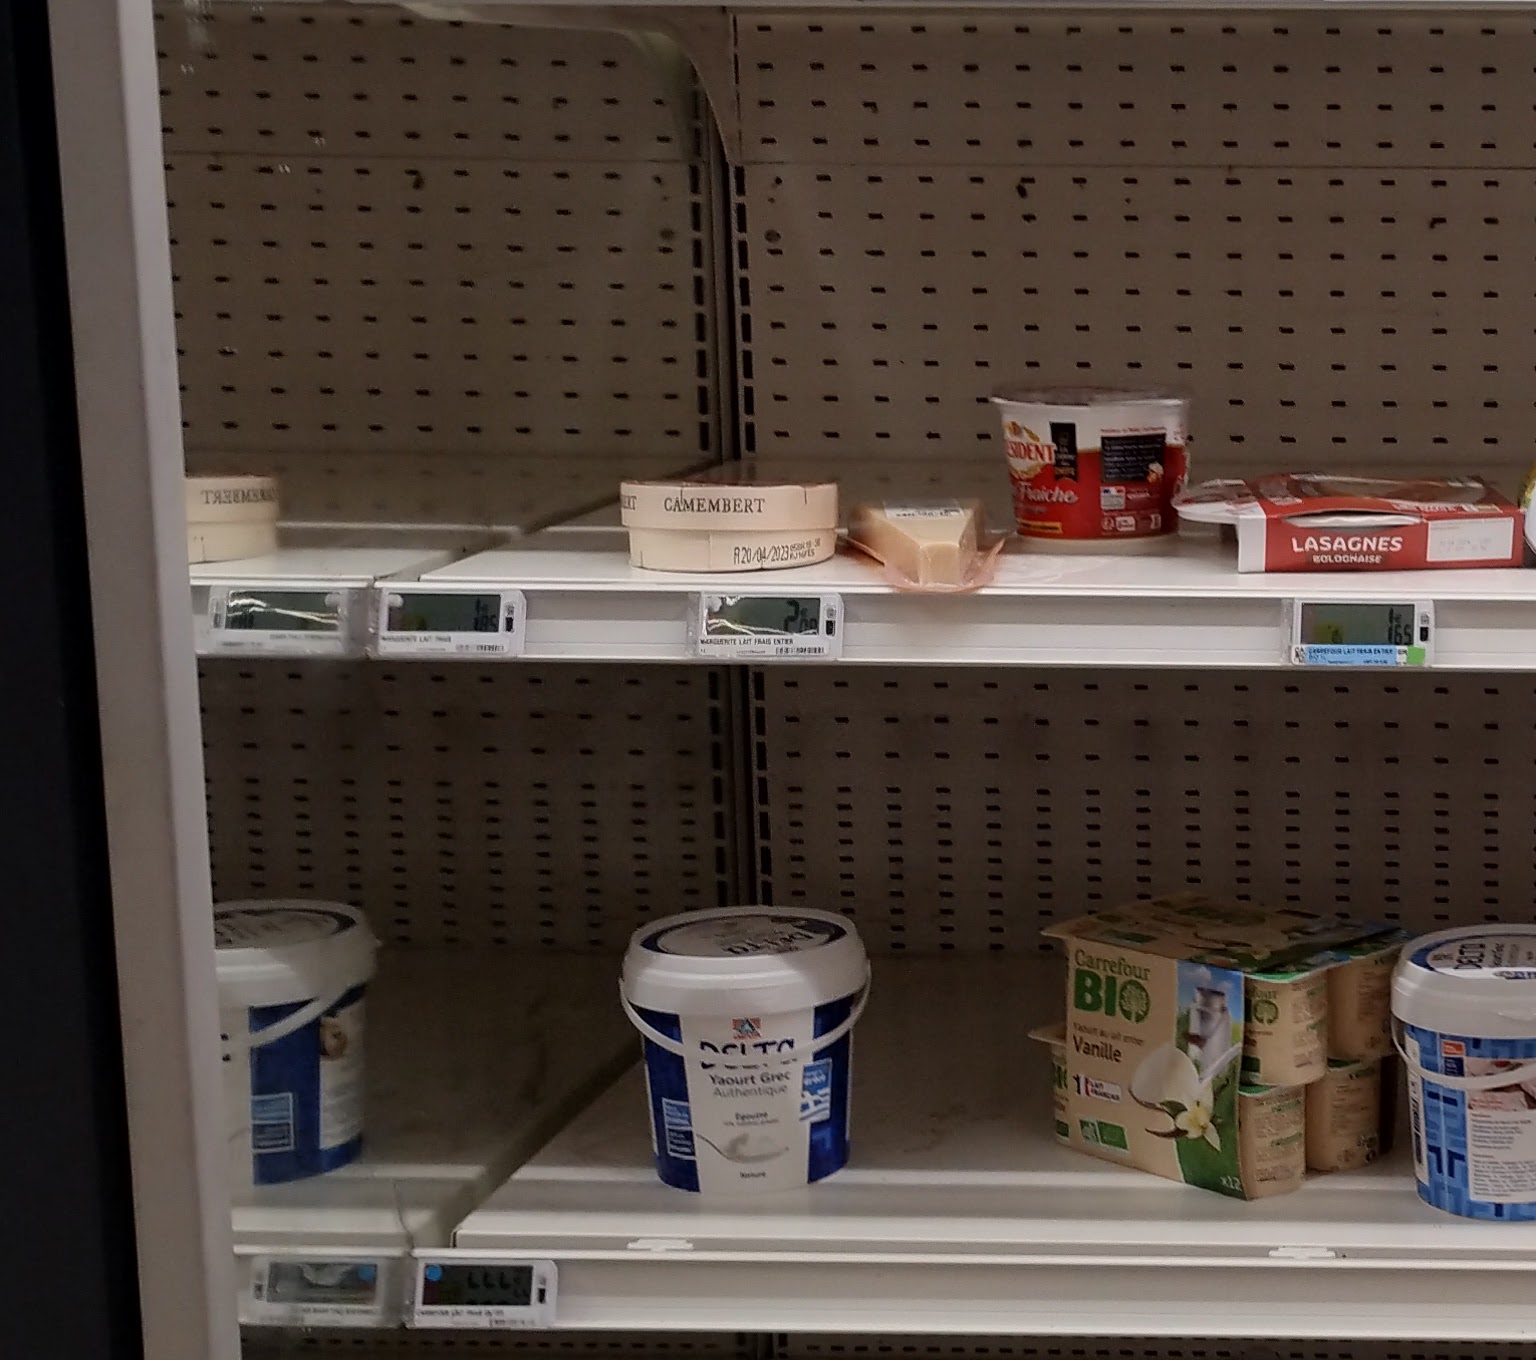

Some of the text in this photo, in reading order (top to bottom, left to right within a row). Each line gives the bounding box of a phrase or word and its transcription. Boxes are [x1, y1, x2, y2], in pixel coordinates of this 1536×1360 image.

[663, 496, 766, 514] CAMEMBERT
[1291, 536, 1404, 553] LASAGNES
[1312, 554, 1383, 565] BOLOGNAISE
[1074, 948, 1151, 981] Carrefour
[1074, 967, 1151, 1024] BIO
[1073, 1035, 1123, 1063] Vanille
[709, 1073, 756, 1086] Yaourt
[760, 1072, 791, 1085] Grec
[714, 1084, 788, 1099] Authentique
